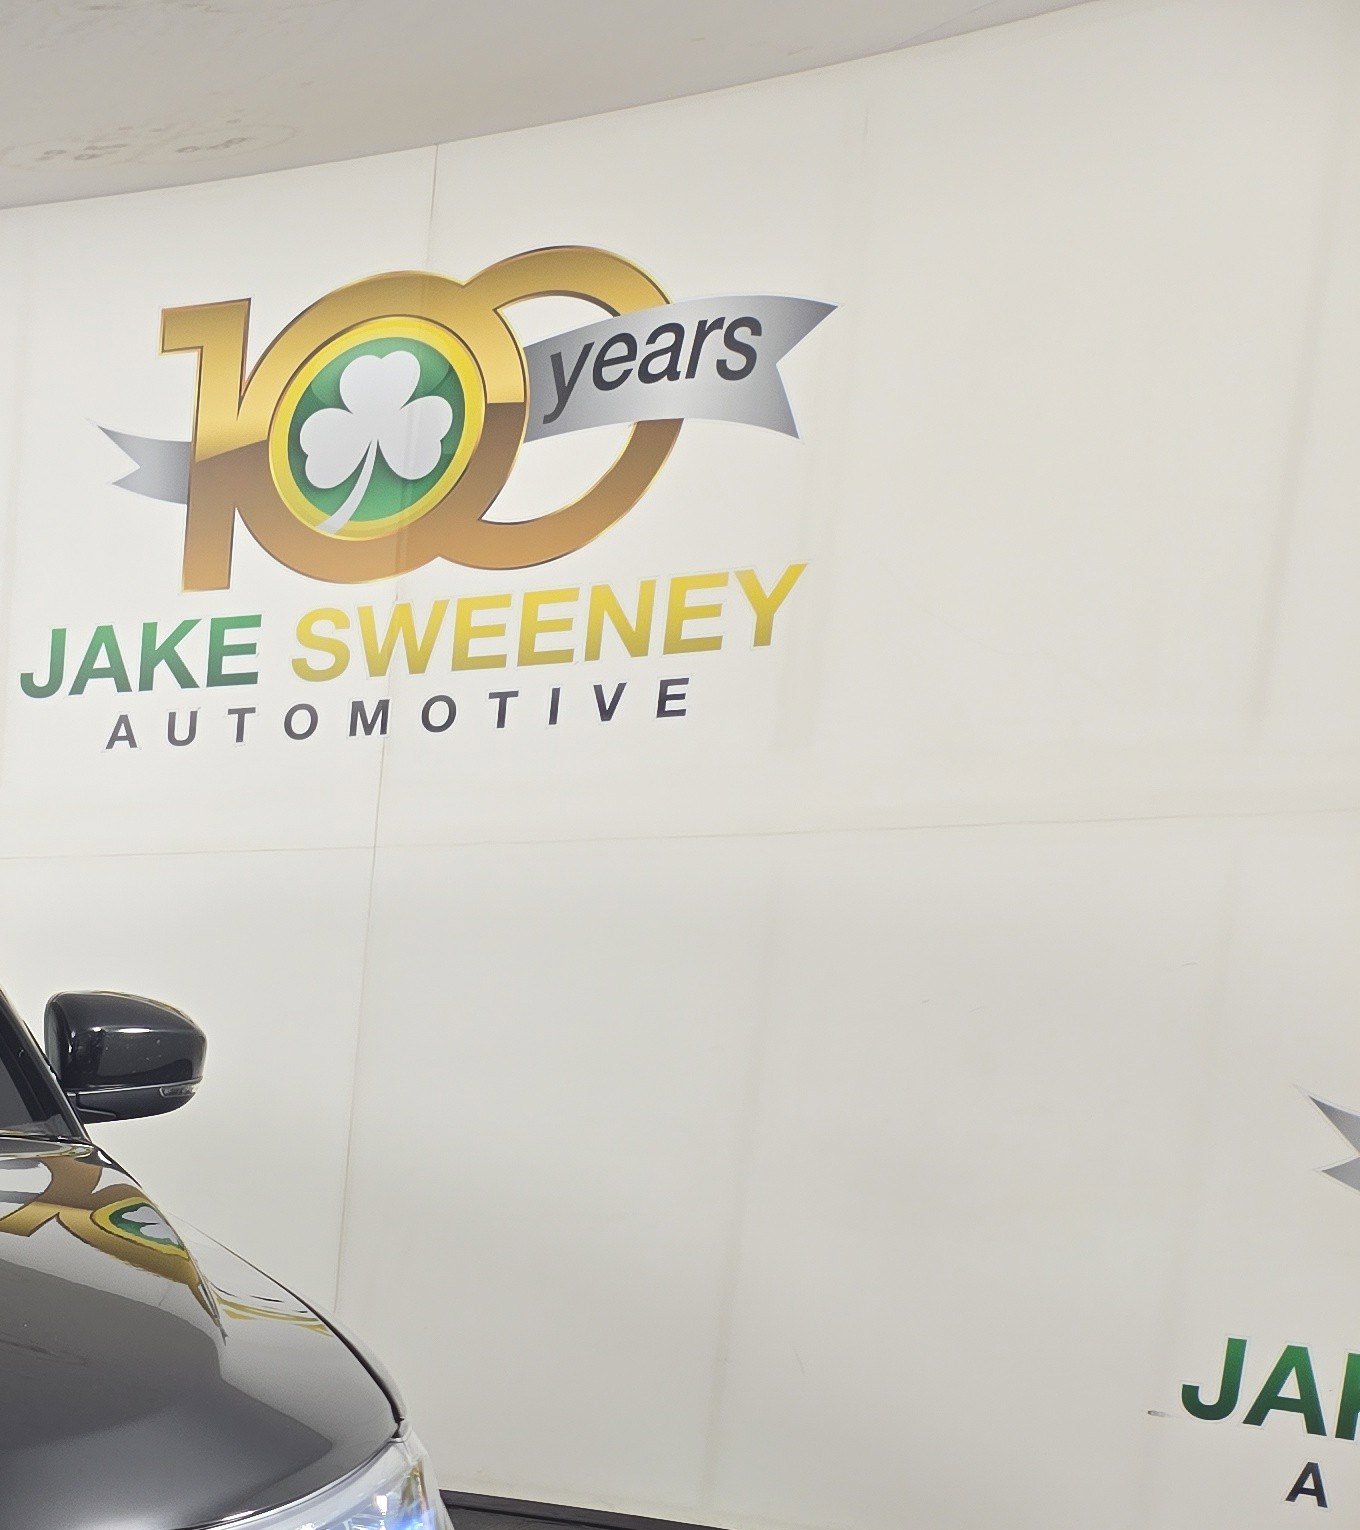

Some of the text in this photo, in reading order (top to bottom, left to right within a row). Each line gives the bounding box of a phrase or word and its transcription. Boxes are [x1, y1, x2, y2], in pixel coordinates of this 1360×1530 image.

[159, 245, 763, 592] 100 years
[20, 562, 810, 700] JAKE SWEENEY
[104, 677, 690, 751] AUTOMOTIVE
[1181, 1336, 1360, 1441] JA
